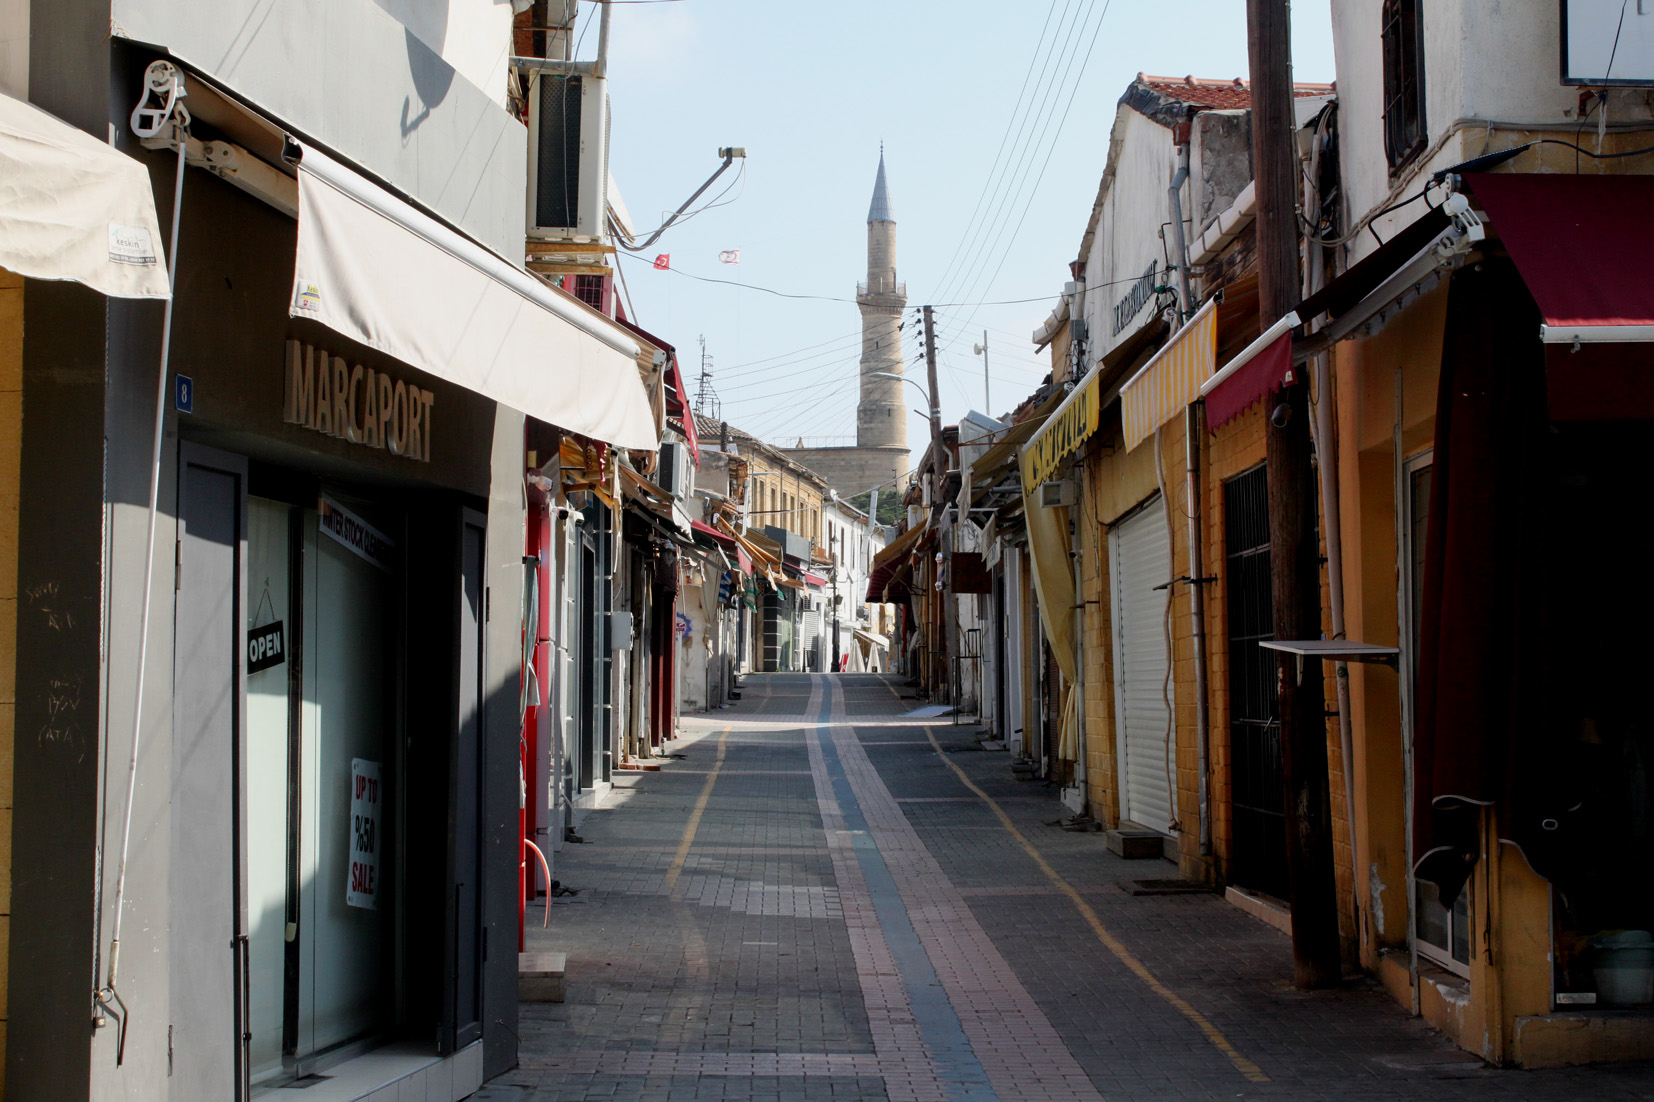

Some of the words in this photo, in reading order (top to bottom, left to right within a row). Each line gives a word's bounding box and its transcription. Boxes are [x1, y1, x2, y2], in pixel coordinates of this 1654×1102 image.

[181, 383, 188, 404] 8
[284, 340, 434, 463] MARCAPORT
[344, 516, 365, 551] STOCK
[250, 631, 281, 662] OPEN
[355, 774, 367, 800] UP
[367, 778, 378, 804] TO
[355, 815, 375, 854] %50
[352, 861, 374, 895] SALE
